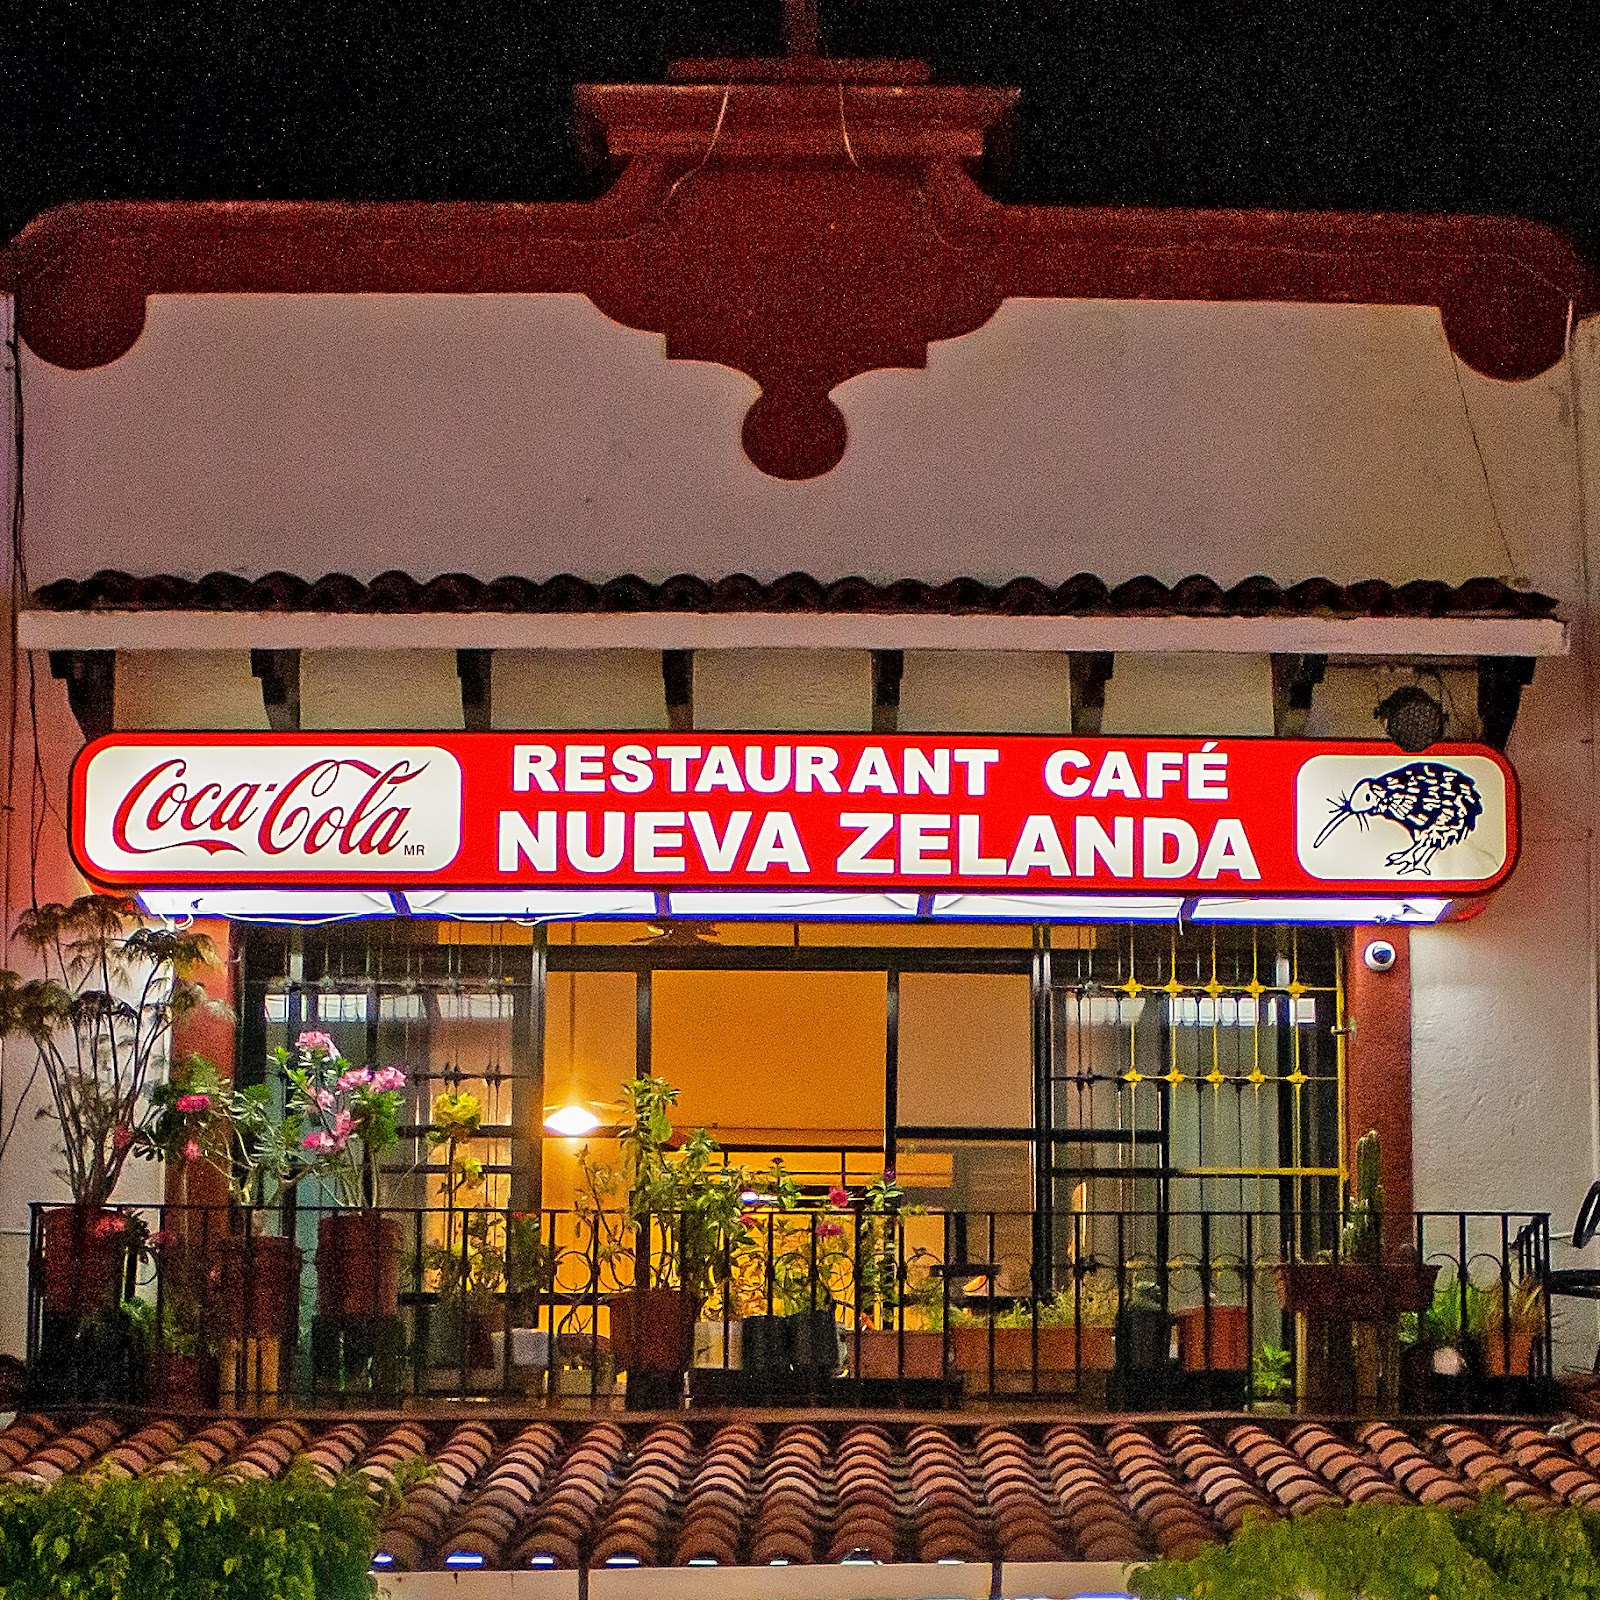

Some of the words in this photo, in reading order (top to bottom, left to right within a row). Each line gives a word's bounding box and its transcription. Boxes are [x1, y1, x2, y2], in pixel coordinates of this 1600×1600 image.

[513, 744, 999, 796] RESTAURANT
[1044, 742, 1229, 800] CAFÉ
[113, 759, 431, 856] Coca-Cola
[403, 844, 425, 856] MR
[498, 810, 811, 874] NUEVA
[837, 812, 1261, 880] ZELANDA
